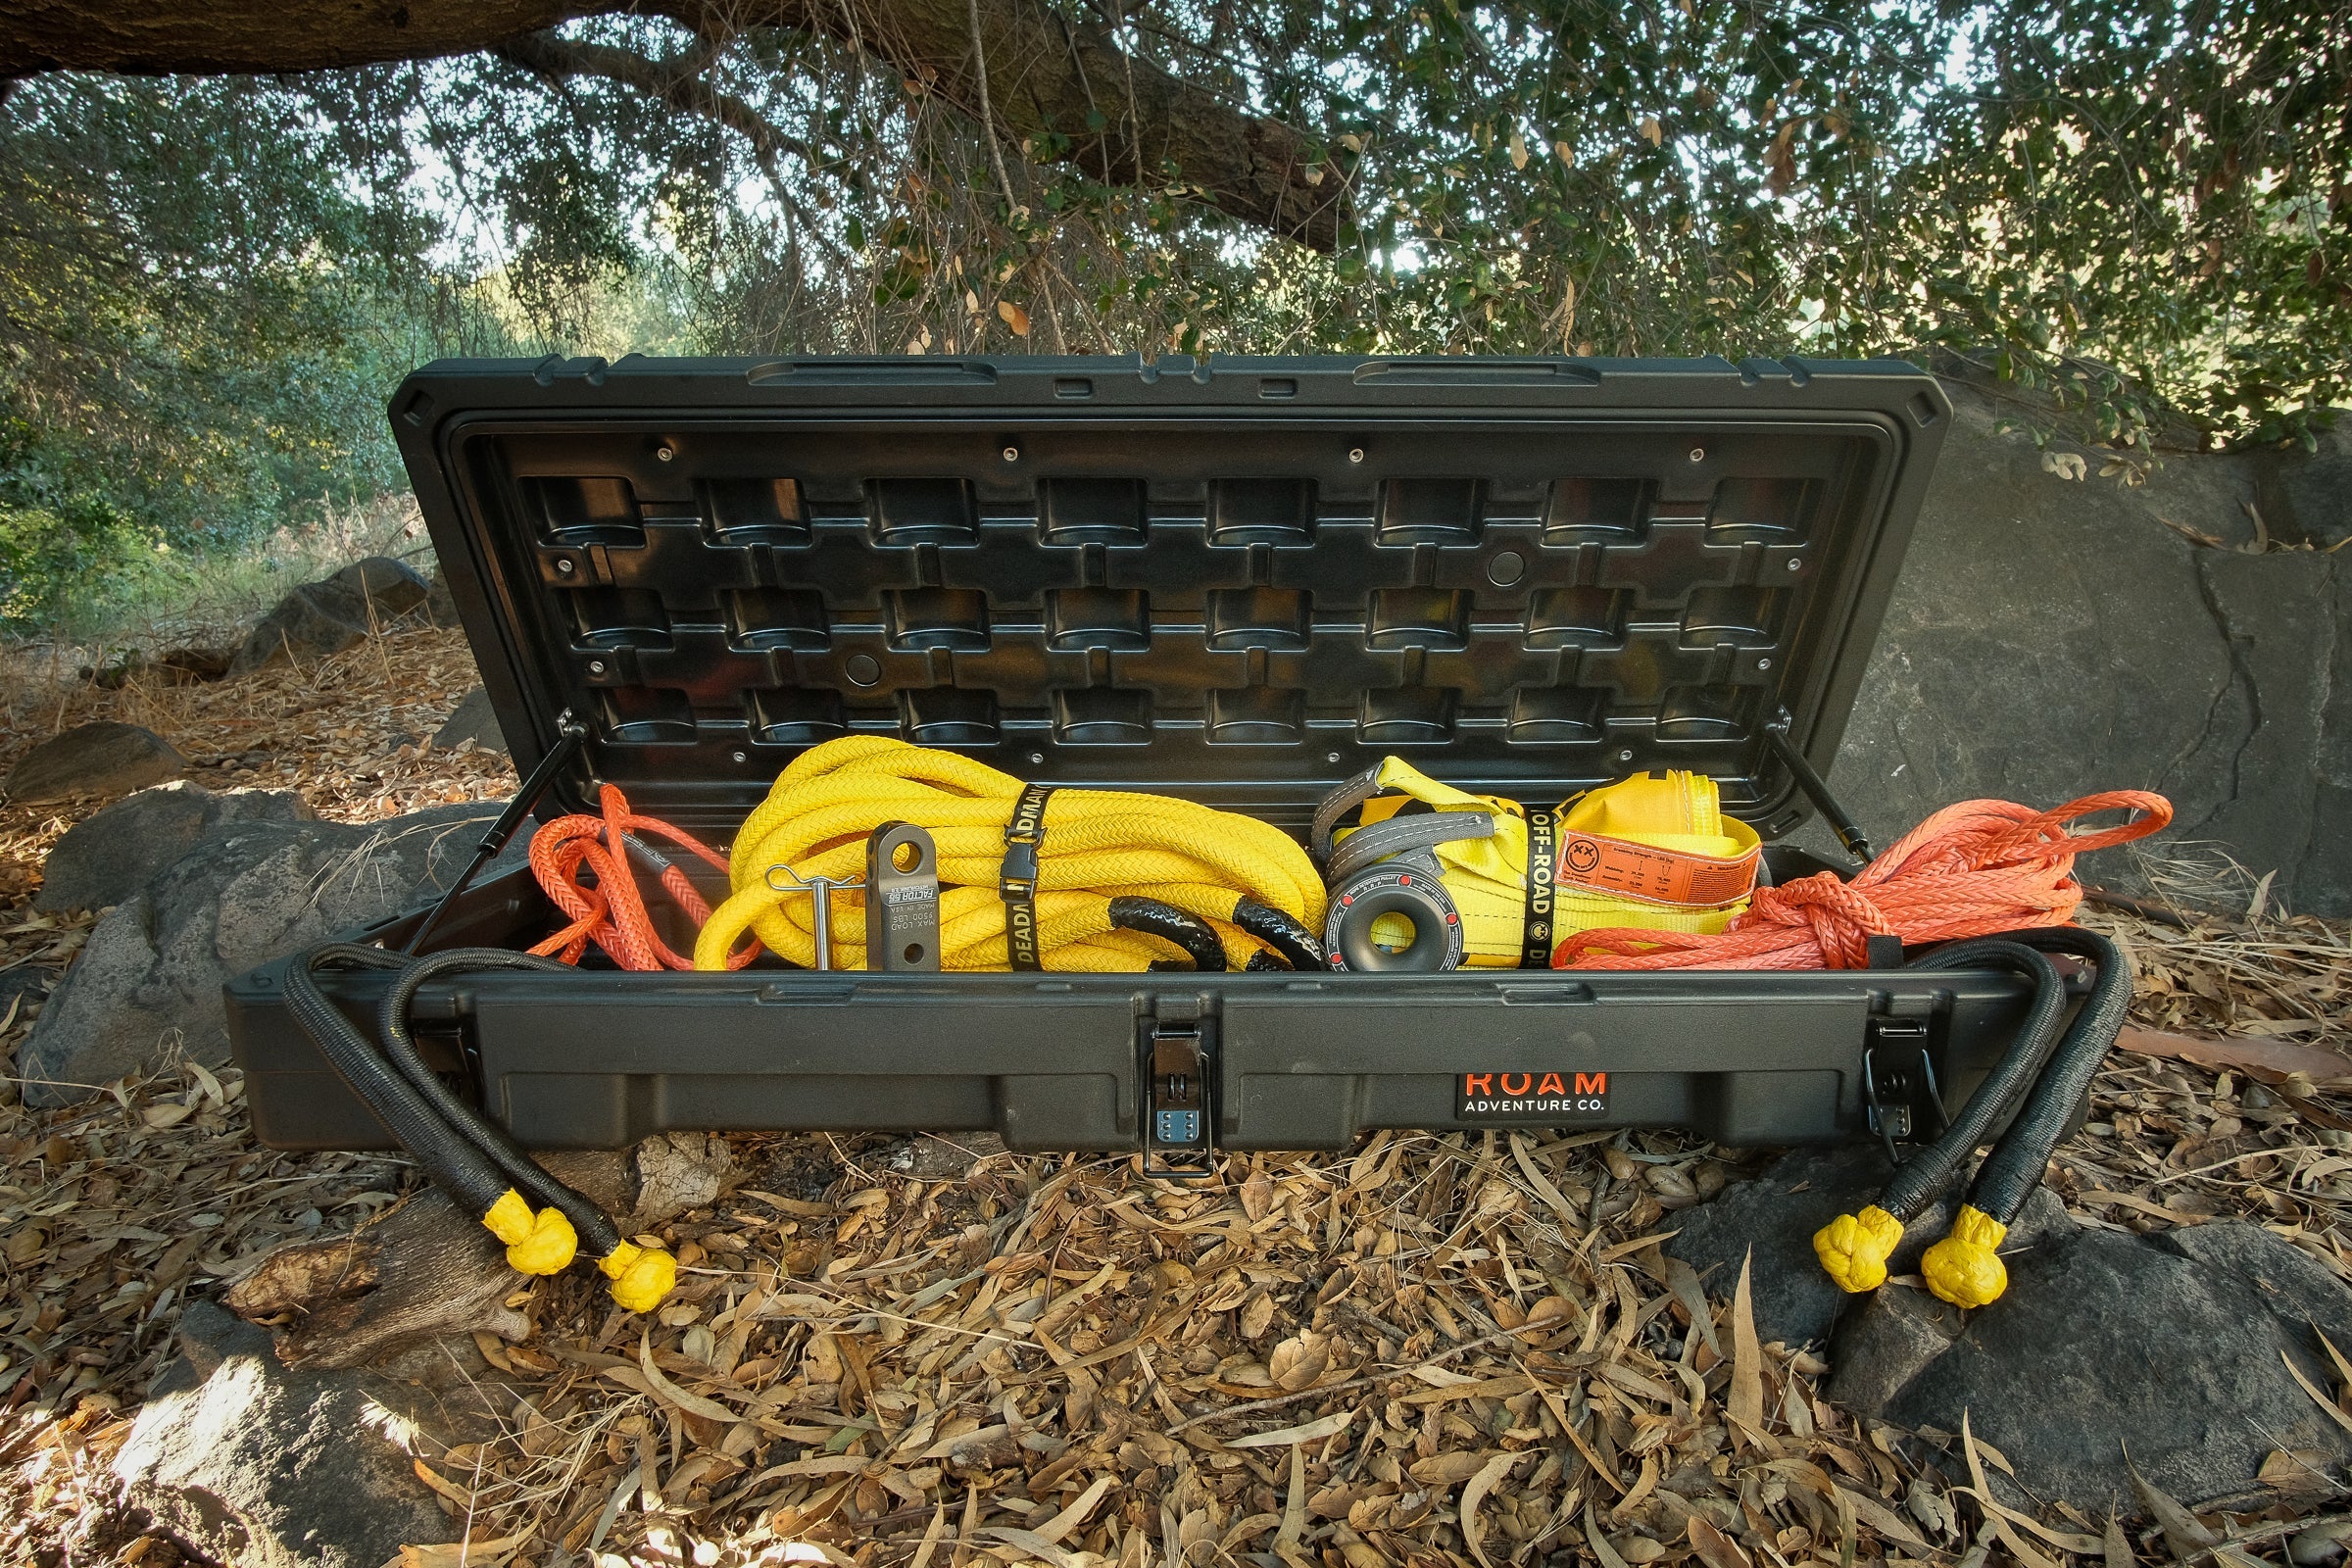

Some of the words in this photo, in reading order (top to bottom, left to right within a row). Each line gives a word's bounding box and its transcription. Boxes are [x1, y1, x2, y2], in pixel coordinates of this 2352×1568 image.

[1532, 814, 1551, 913] OFF-ROAD
[903, 889, 934, 901] FACTOR
[912, 912, 933, 921] 9500
[891, 922, 913, 931] LOAD
[1466, 1072, 1606, 1096] ROAM
[1465, 1100, 1571, 1112] ADVENTURE
[1577, 1099, 1604, 1111] CO.
